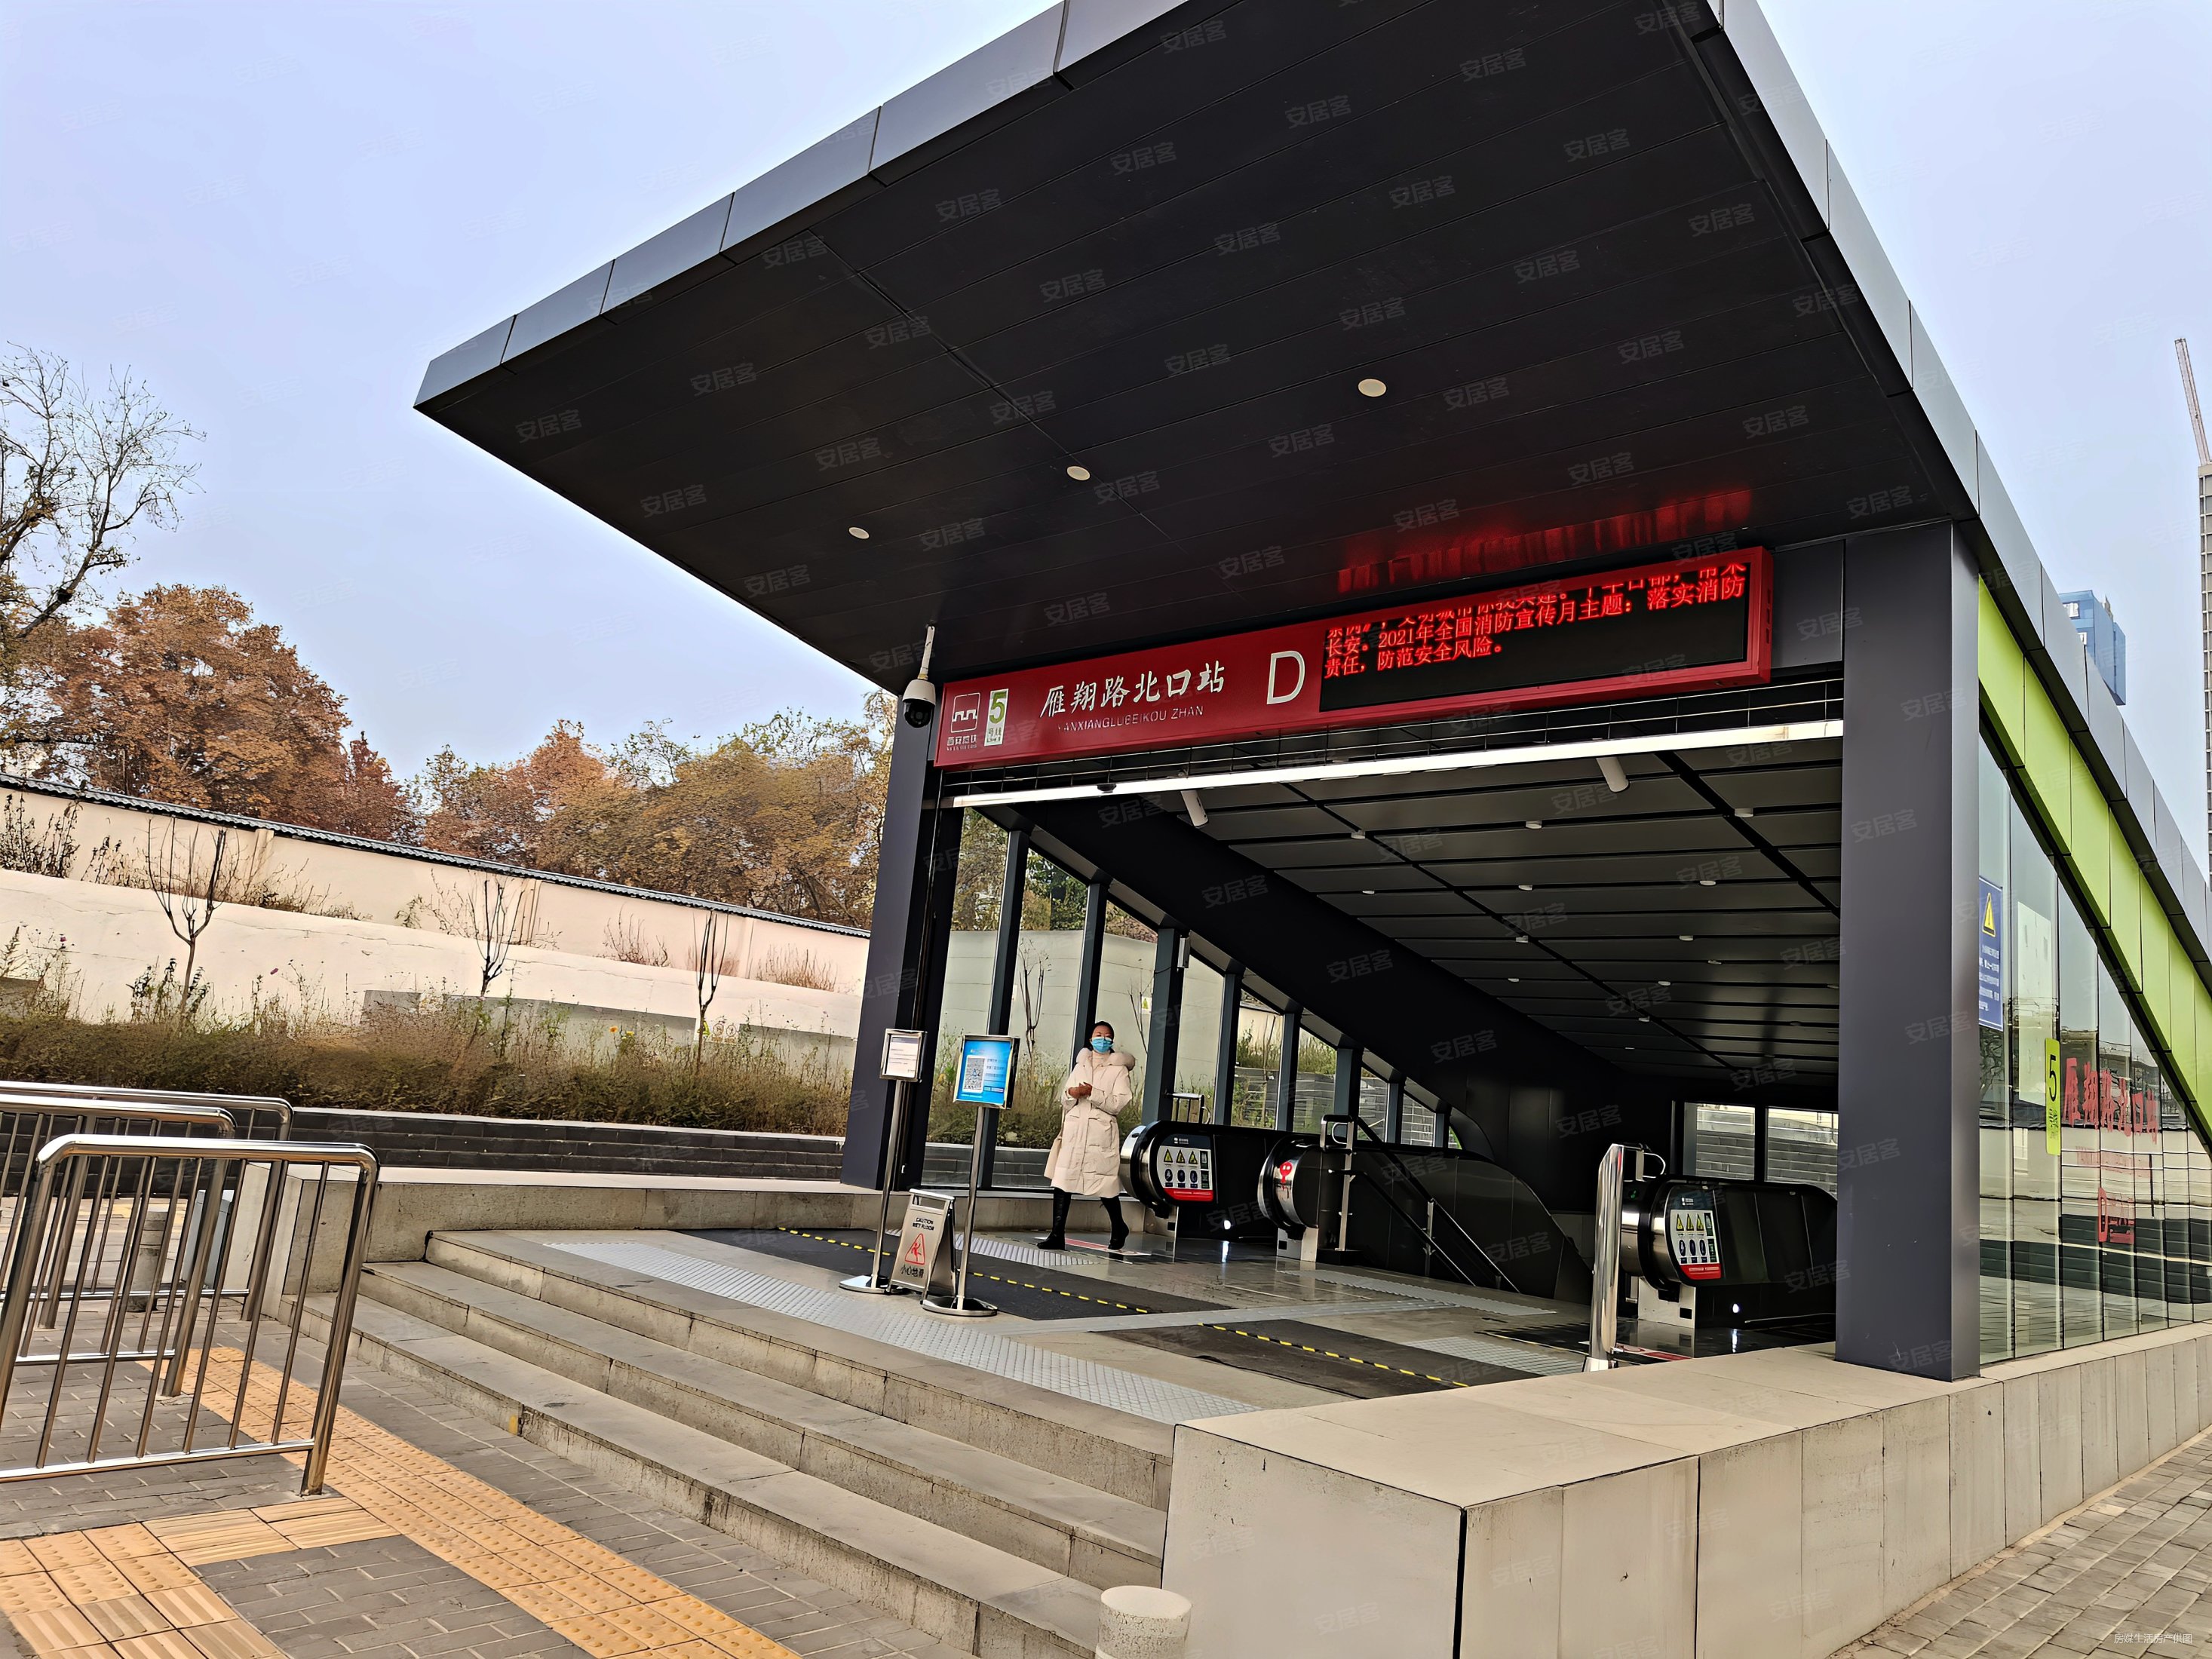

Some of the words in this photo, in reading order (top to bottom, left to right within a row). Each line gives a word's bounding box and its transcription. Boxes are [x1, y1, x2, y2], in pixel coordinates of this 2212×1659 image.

[1040, 660, 1226, 718] 雁翔路北口站
[1266, 650, 1306, 705] D
[989, 692, 1006, 724] 5
[1170, 706, 1204, 719] ZHAN
[2049, 1054, 2057, 1102] 5
